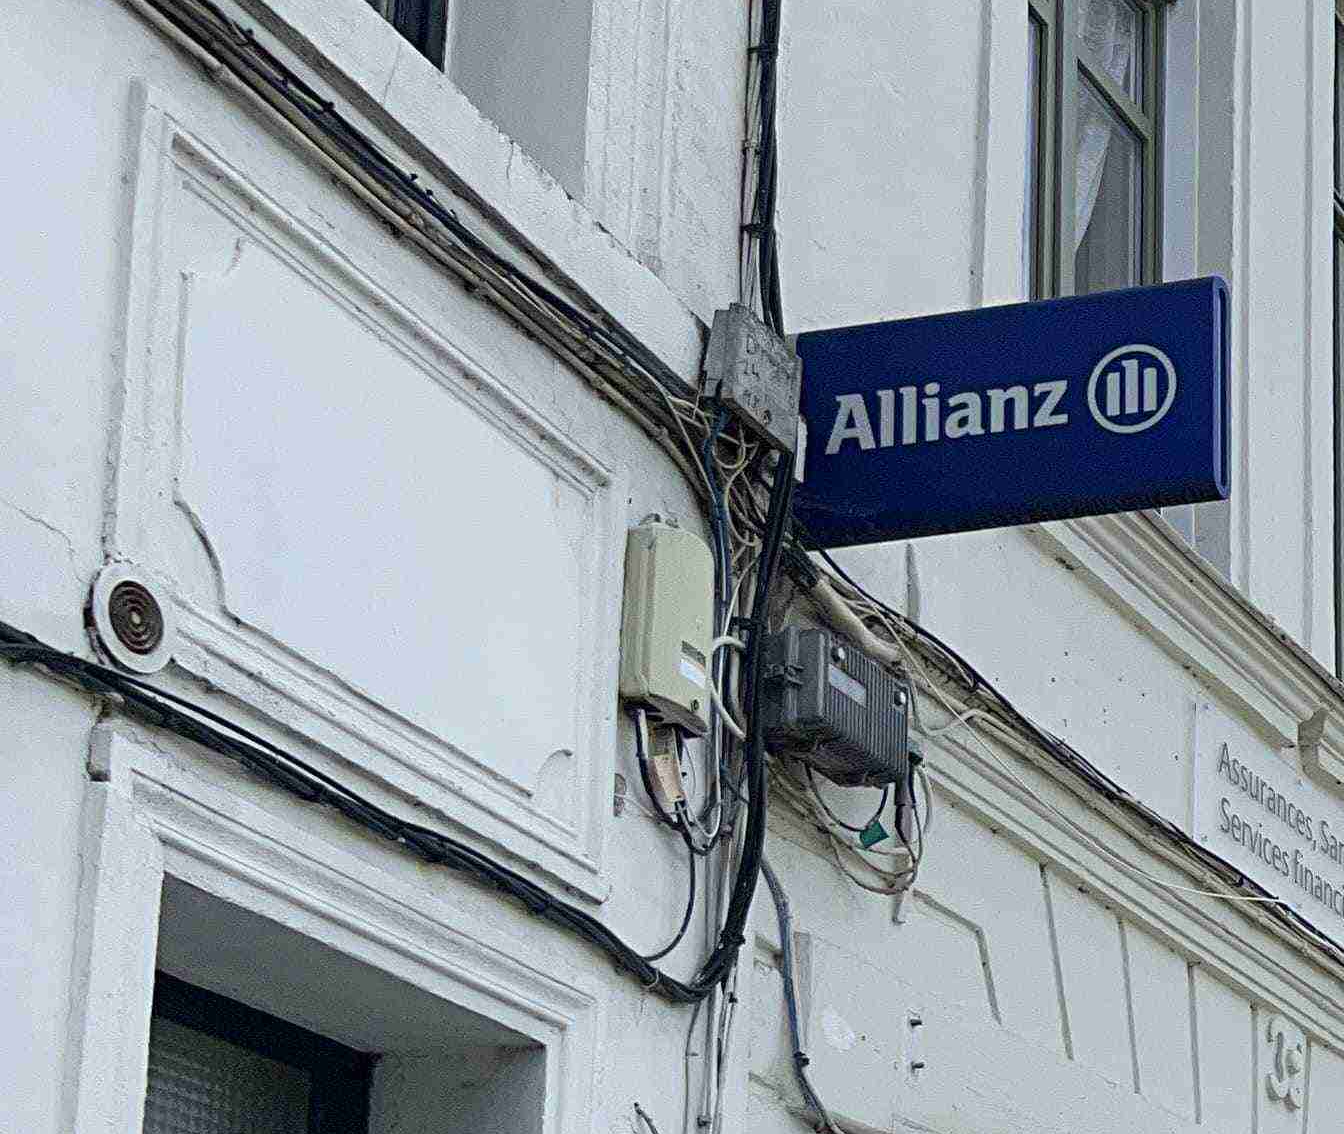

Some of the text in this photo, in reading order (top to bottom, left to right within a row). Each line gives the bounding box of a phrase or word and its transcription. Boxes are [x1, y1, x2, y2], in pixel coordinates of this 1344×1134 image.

[825, 379, 1069, 455] Allianz
[1218, 742, 1317, 851] Assurances,
[1220, 797, 1289, 878] Services
